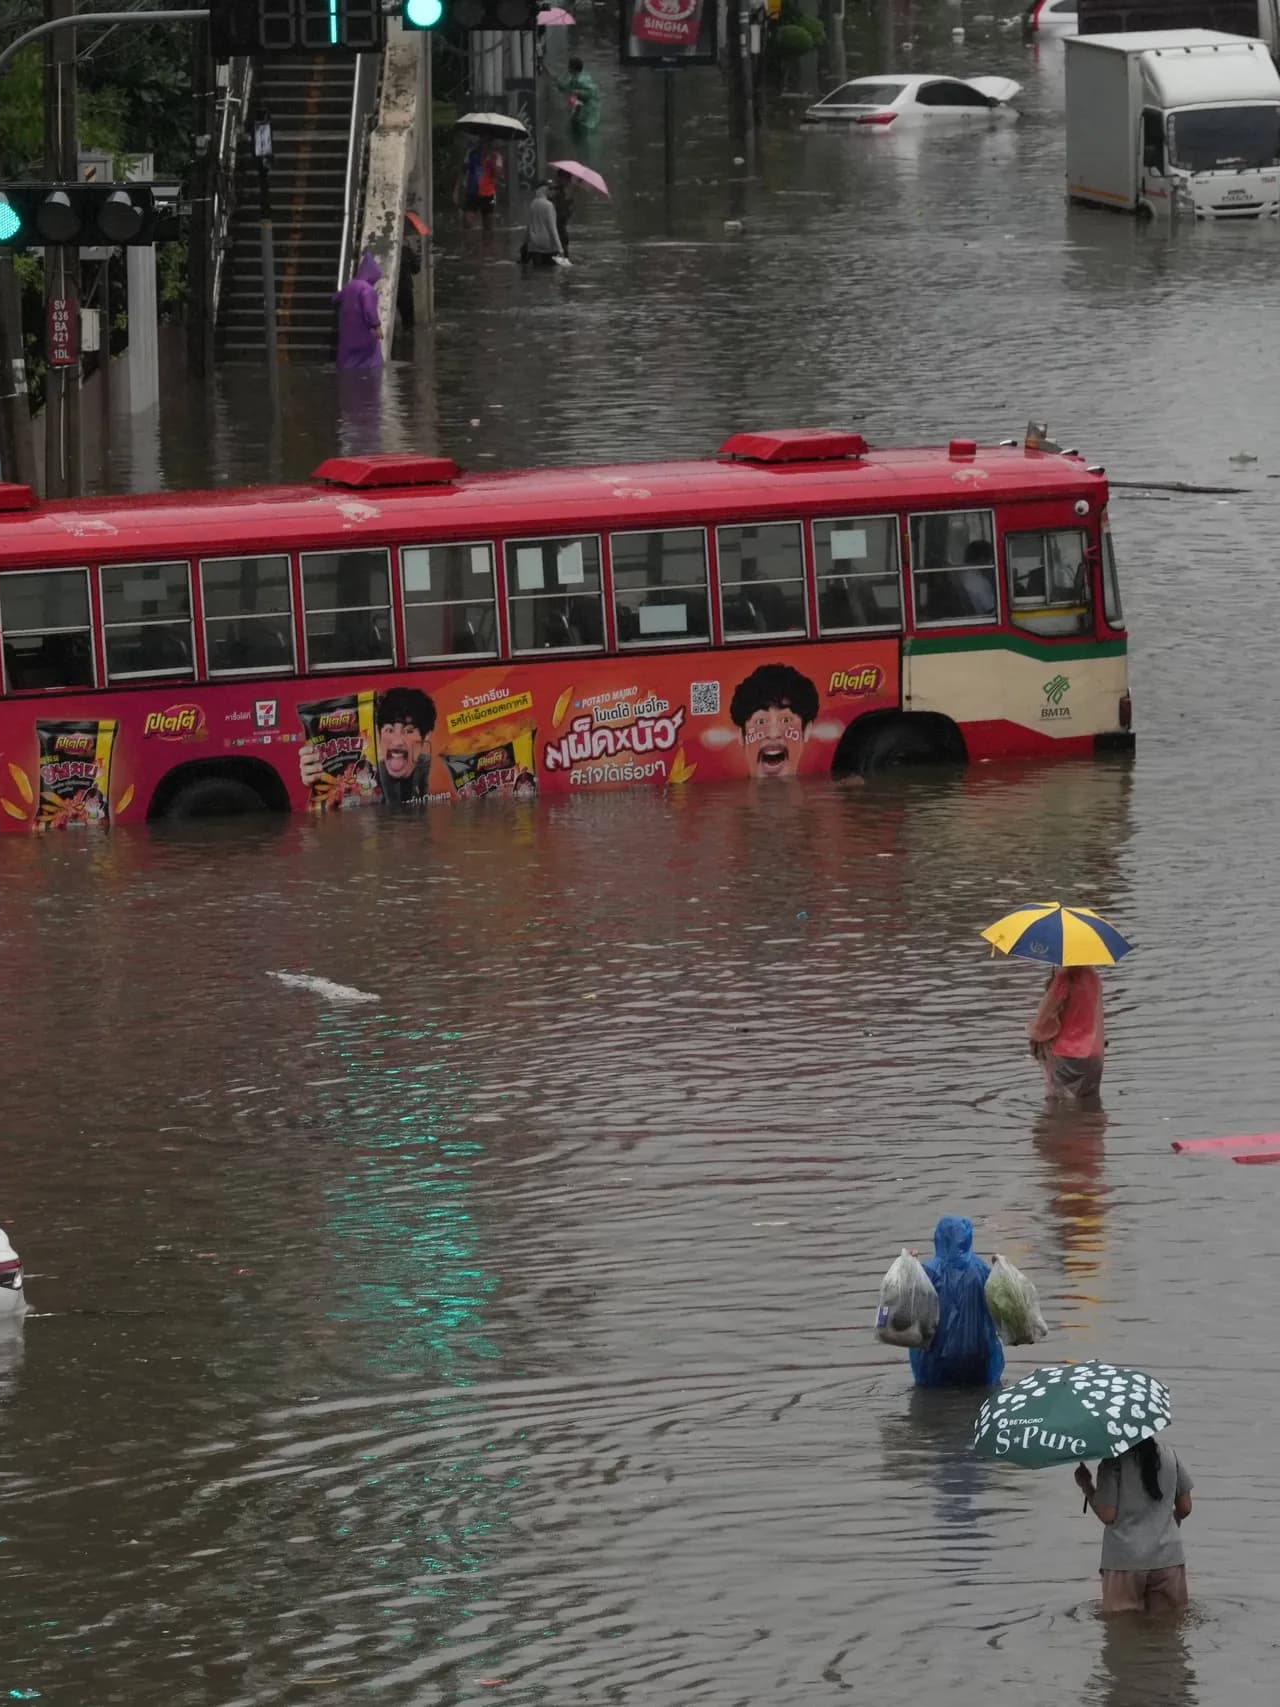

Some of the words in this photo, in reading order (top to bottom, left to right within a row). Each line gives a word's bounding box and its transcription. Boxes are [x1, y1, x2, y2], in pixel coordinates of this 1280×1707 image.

[644, 16, 689, 33] SINGHA
[54, 300, 66, 310] SV
[54, 322, 67, 331] BA
[53, 332, 69, 342] 421
[461, 687, 510, 709] ข้าวเกรียบ
[582, 693, 611, 709] POTATO
[612, 686, 638, 701] MAJIKO
[1041, 707, 1071, 718] BMTA
